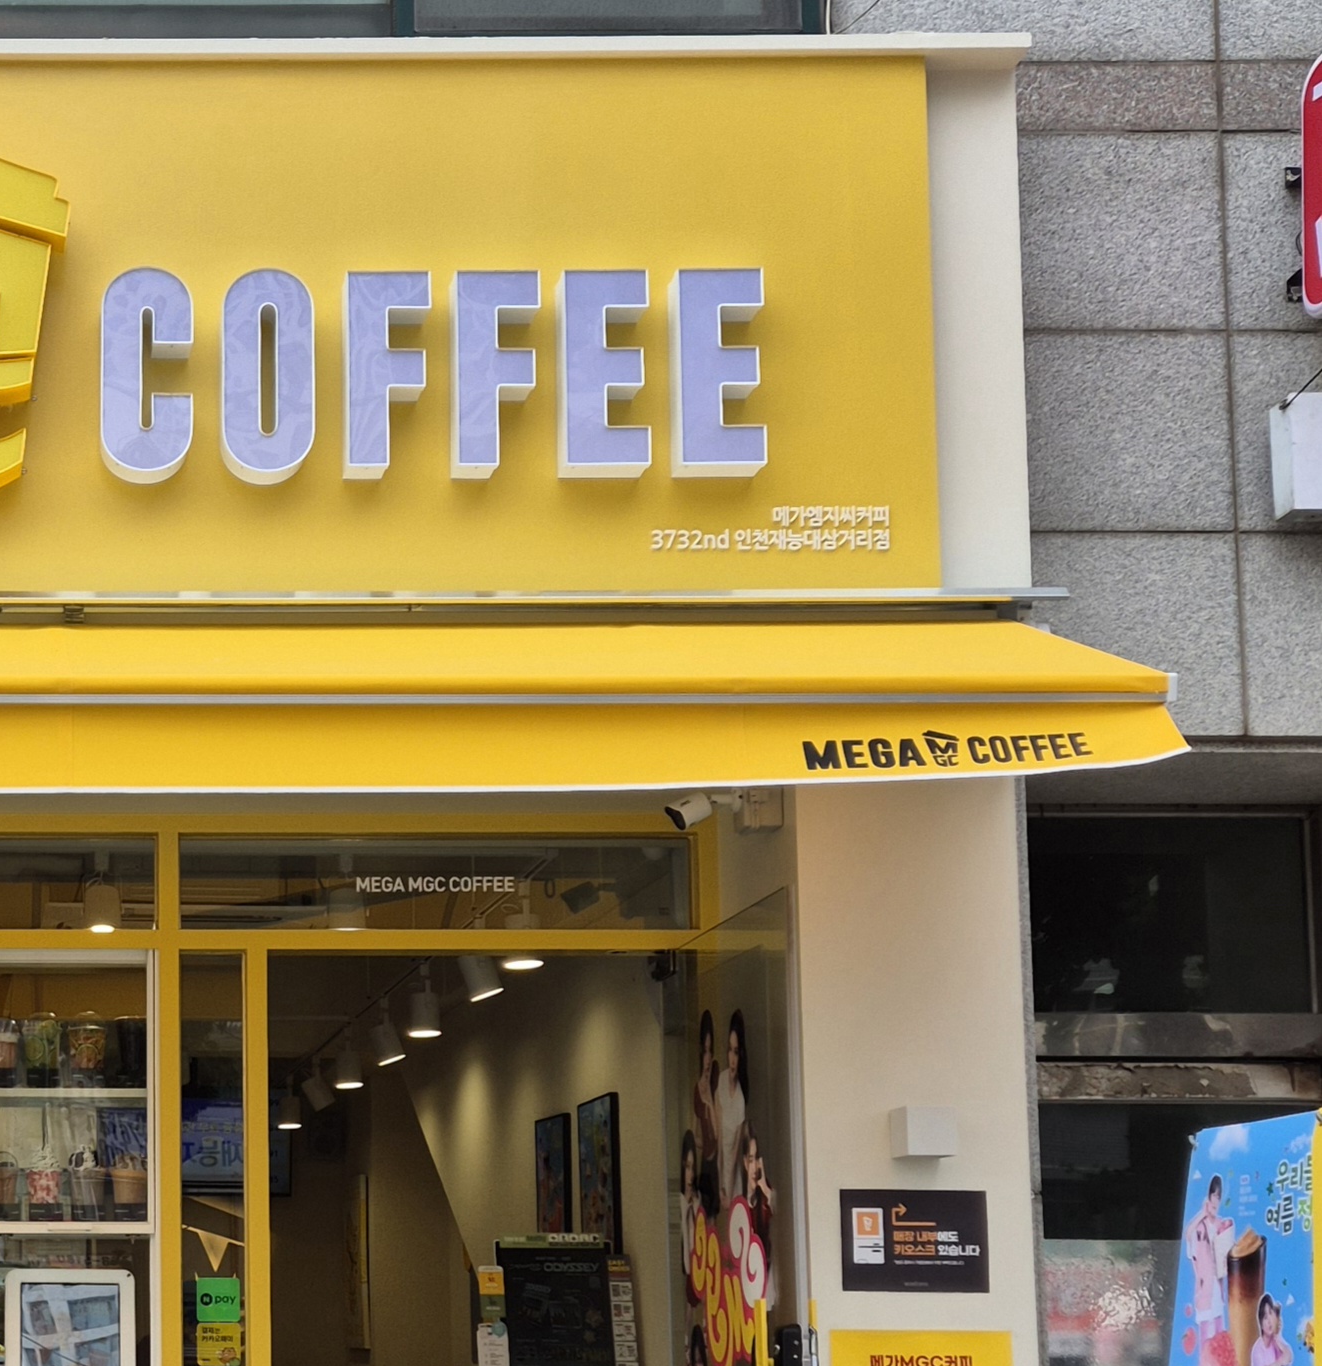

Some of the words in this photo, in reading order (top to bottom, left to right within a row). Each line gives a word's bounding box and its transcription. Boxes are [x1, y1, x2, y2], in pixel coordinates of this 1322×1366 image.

[100, 266, 767, 483] COFFEE
[772, 505, 890, 527] 메가엠지씨커피
[650, 529, 730, 550] 3732nd
[734, 528, 891, 551] 인천재능대삼거리점
[802, 738, 927, 770] MEGA
[967, 732, 1094, 765] COFFEE
[356, 876, 406, 892] MEGA
[408, 876, 446, 892] MGC
[449, 876, 515, 892] COFFEE
[894, 1245, 936, 1256] 키오스크
[938, 1245, 981, 1257] 있습니다
[214, 1294, 236, 1306] pay
